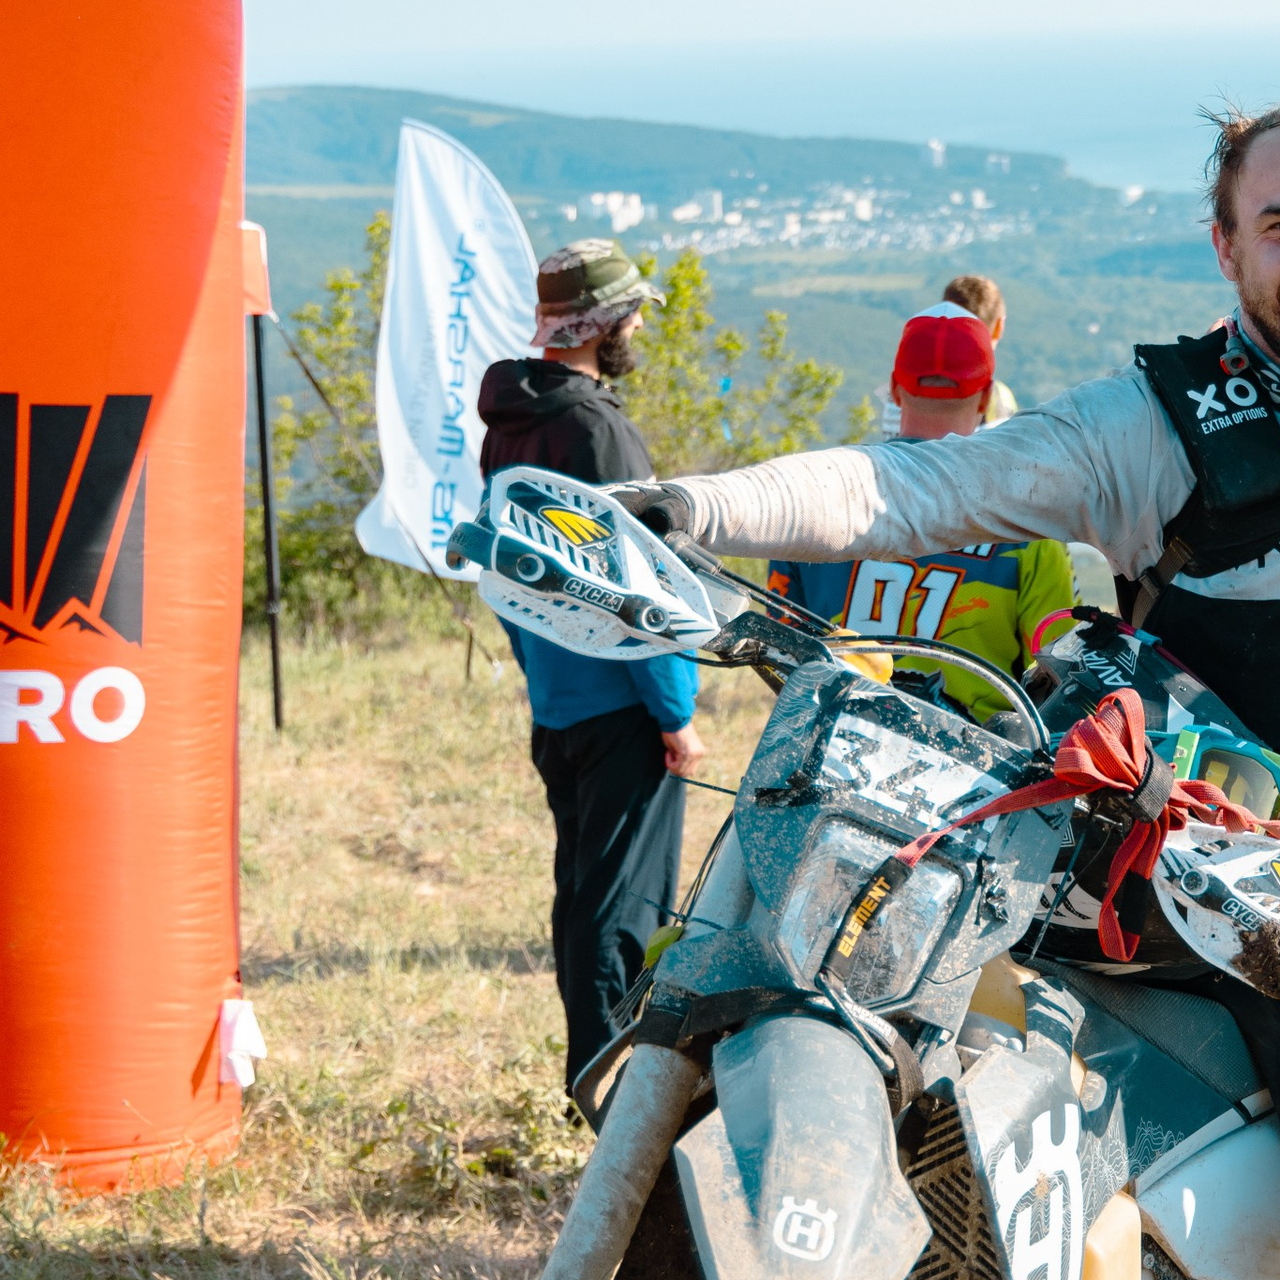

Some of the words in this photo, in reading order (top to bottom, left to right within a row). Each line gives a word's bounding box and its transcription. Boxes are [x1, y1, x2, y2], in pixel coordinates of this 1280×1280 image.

[1186, 376, 1258, 420] XO
[1201, 415, 1233, 435] EXTRA
[1231, 407, 1268, 424] OPTIONS
[563, 577, 625, 613] CYCRA
[1083, 649, 1133, 686] AVIA
[837, 875, 892, 958] ELEMENT
[1221, 897, 1264, 931] CYC
